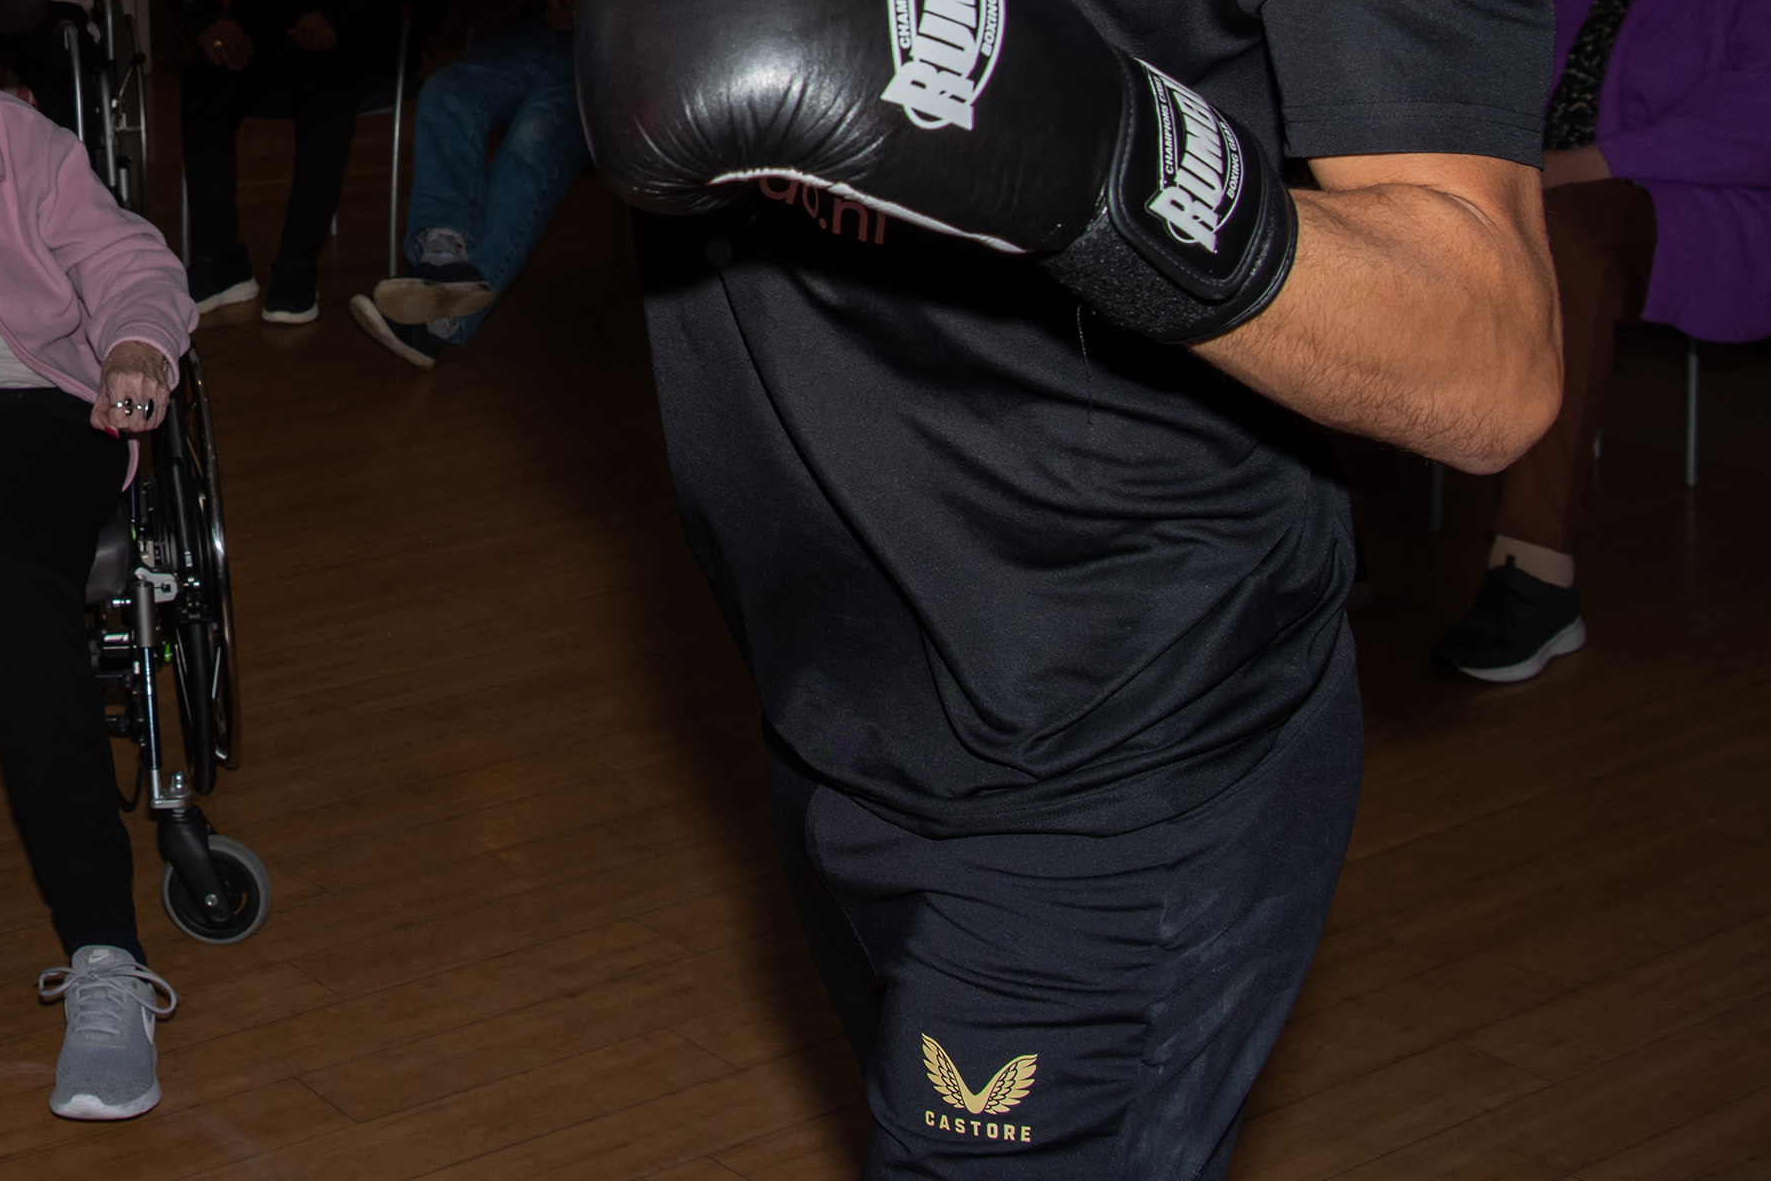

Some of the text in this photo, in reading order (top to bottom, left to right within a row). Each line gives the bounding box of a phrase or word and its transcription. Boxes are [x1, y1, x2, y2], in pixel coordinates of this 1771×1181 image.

[1160, 104, 1175, 175] CHAMPIONS
[1227, 154, 1239, 199] BOXING
[925, 1110, 1032, 1143] CASTORE
